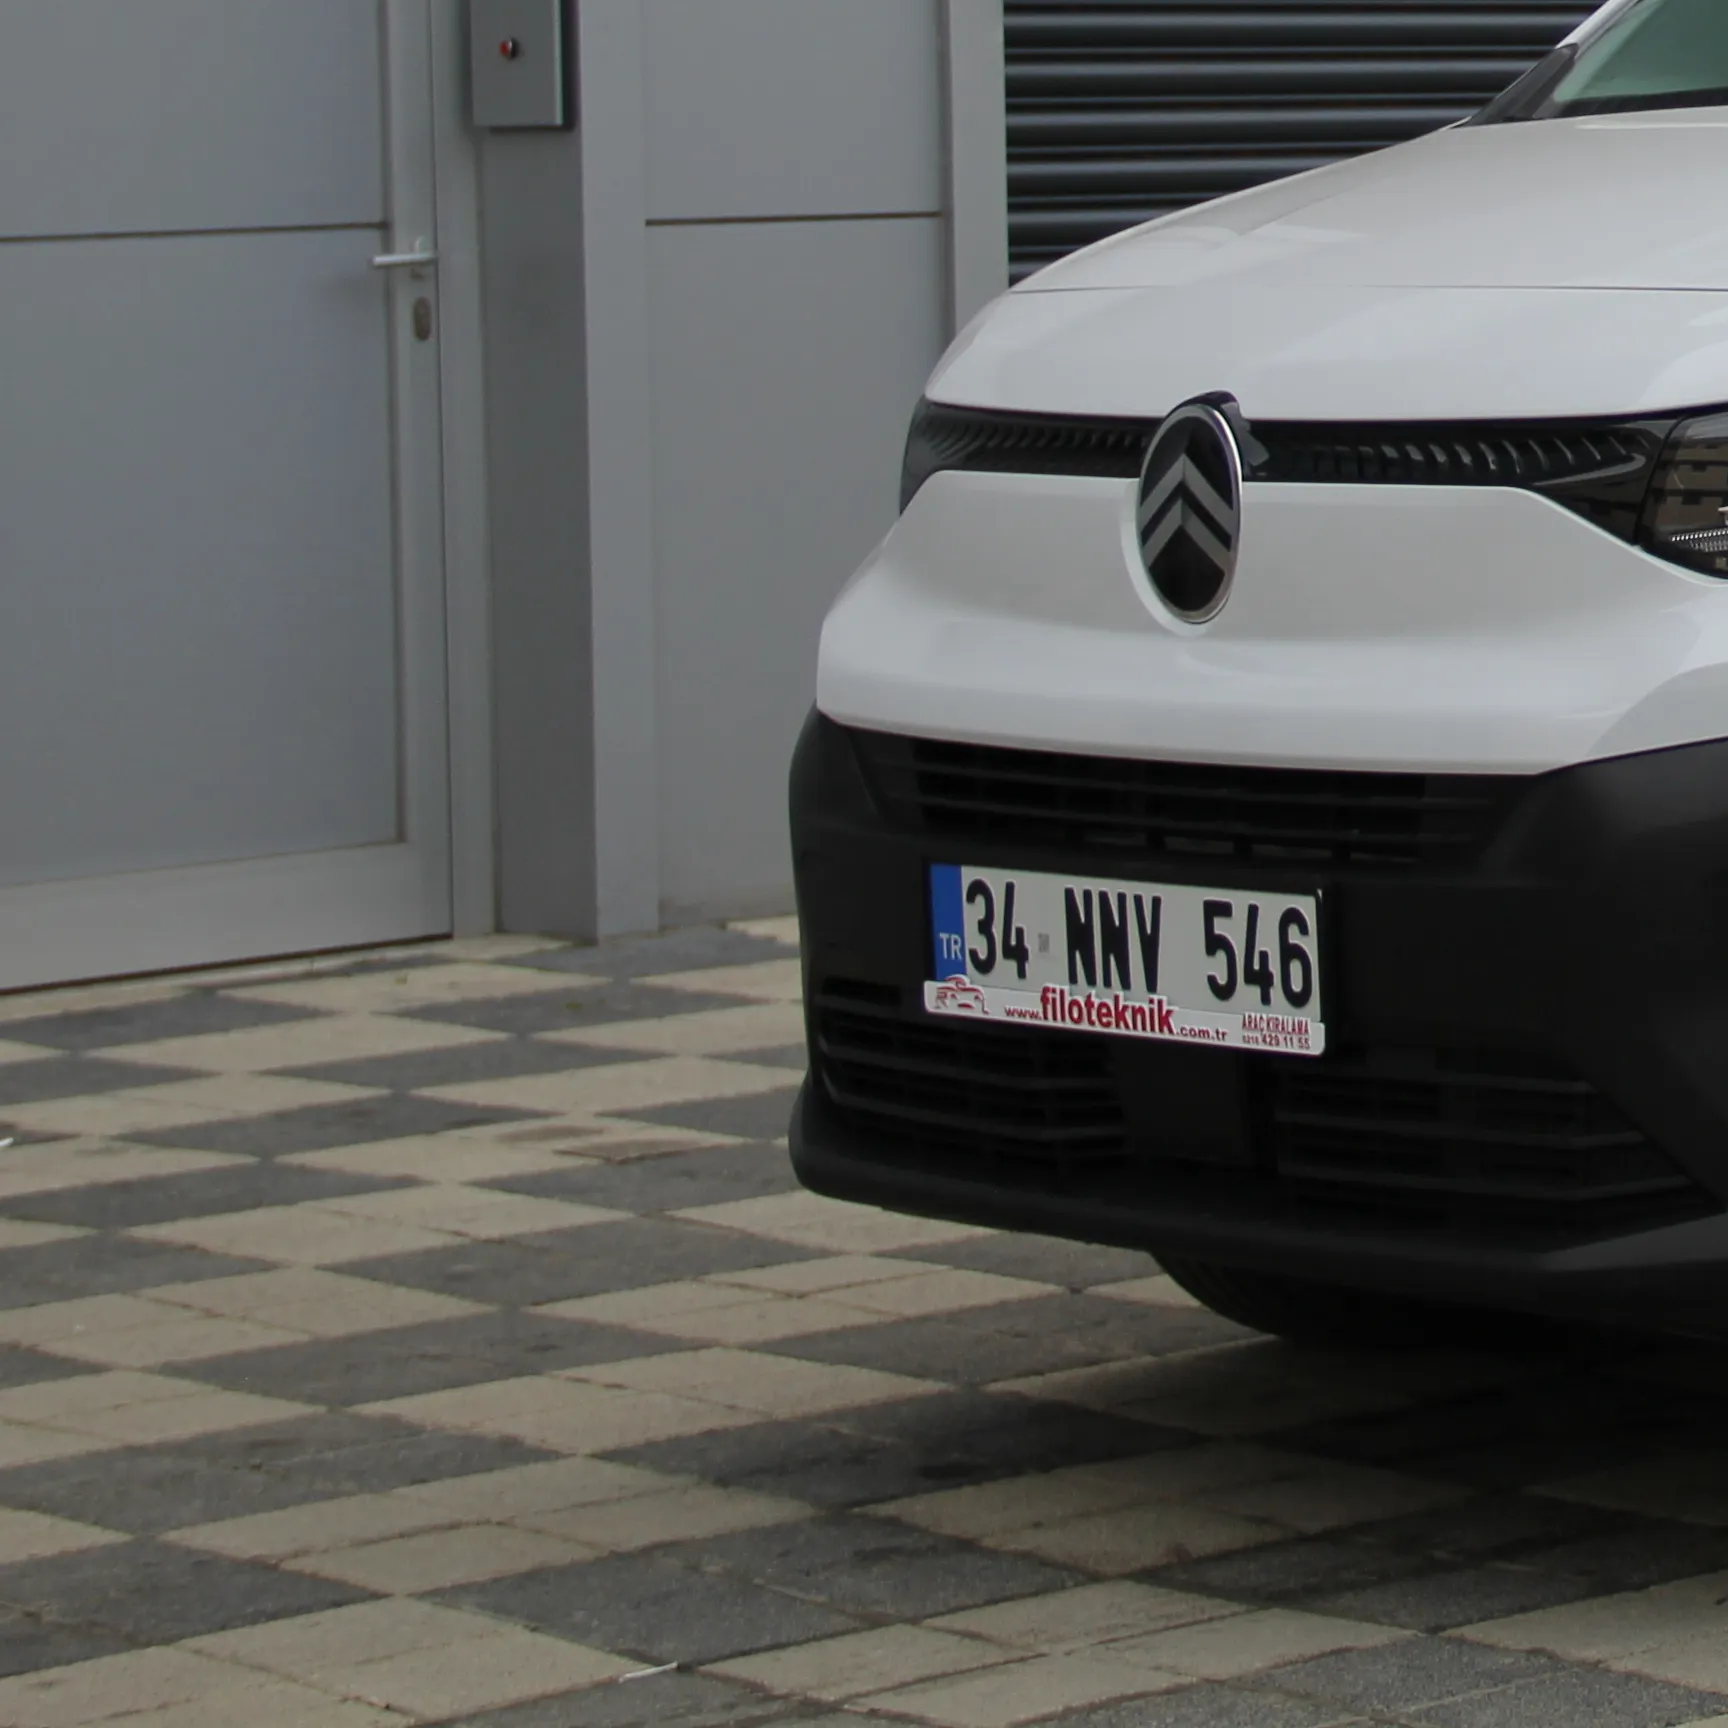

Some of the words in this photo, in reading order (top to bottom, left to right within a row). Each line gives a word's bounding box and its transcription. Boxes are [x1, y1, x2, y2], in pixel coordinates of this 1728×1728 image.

[939, 932, 963, 960] TR
[966, 878, 1029, 979] 34
[1064, 887, 1162, 993] NNV
[1203, 899, 1313, 1008] 546
[1004, 986, 1228, 1042] www.filoteknik.com.tr
